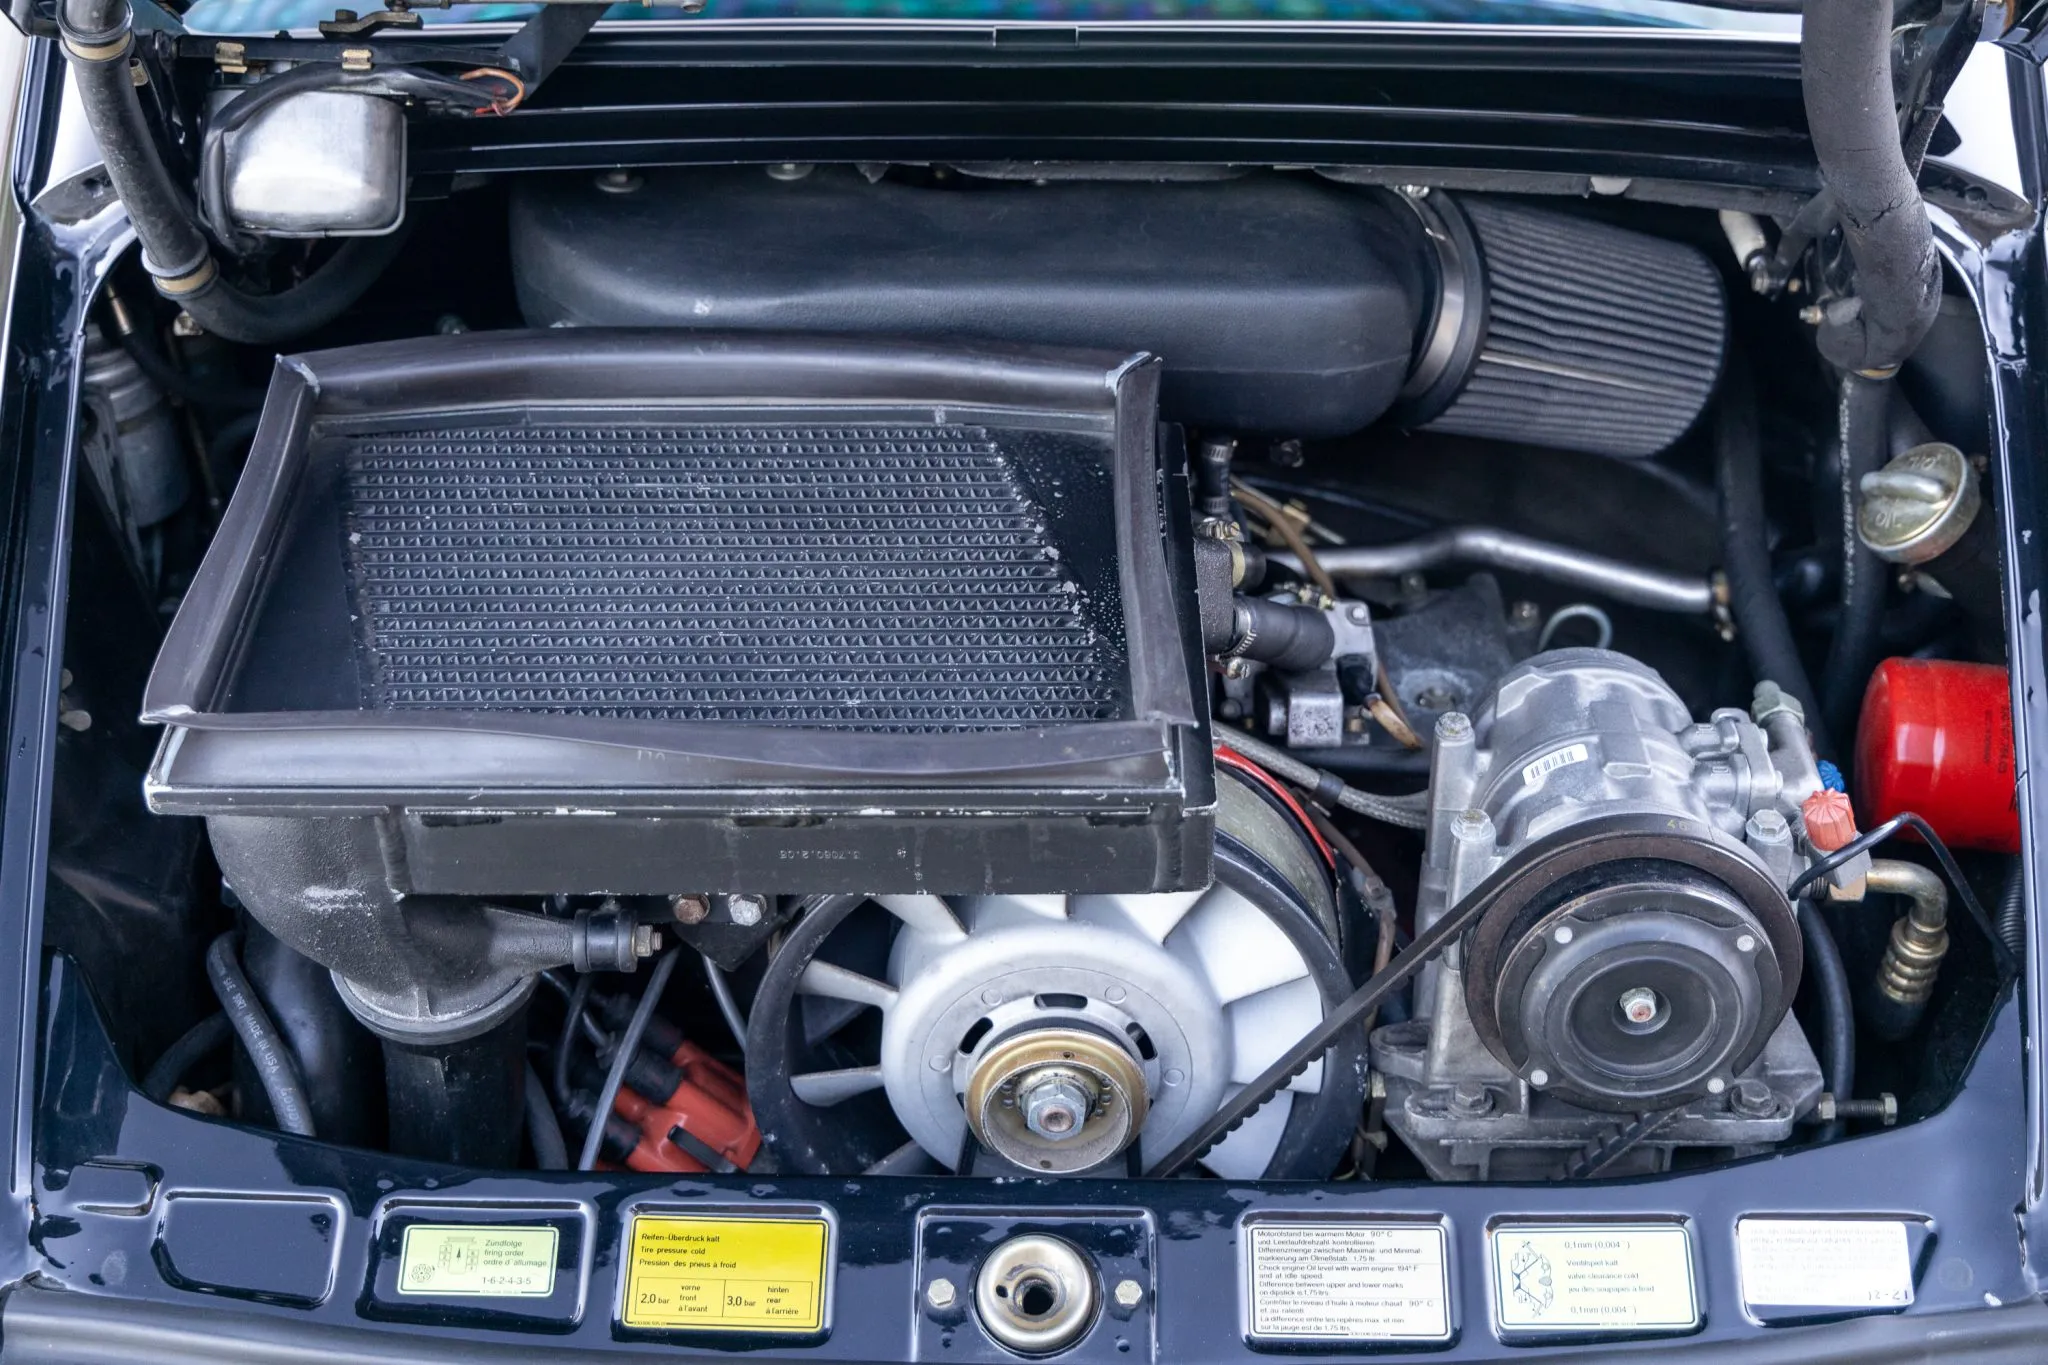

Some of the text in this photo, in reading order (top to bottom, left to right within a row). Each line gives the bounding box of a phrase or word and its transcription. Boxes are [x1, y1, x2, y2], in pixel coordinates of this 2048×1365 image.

[244, 1012, 263, 1039] MADE
[264, 1051, 281, 1074] USA
[706, 1235, 720, 1243] kalt
[484, 1249, 504, 1258] firing
[656, 1247, 688, 1256] pressure
[690, 1247, 706, 1255] cold
[639, 1259, 670, 1267] Pression
[689, 1261, 711, 1269] pneus
[720, 1260, 737, 1269] froid
[767, 1286, 790, 1294] hinten
[640, 1293, 657, 1305] 2,0
[679, 1293, 697, 1301] front
[726, 1295, 756, 1307] 3,0 bar
